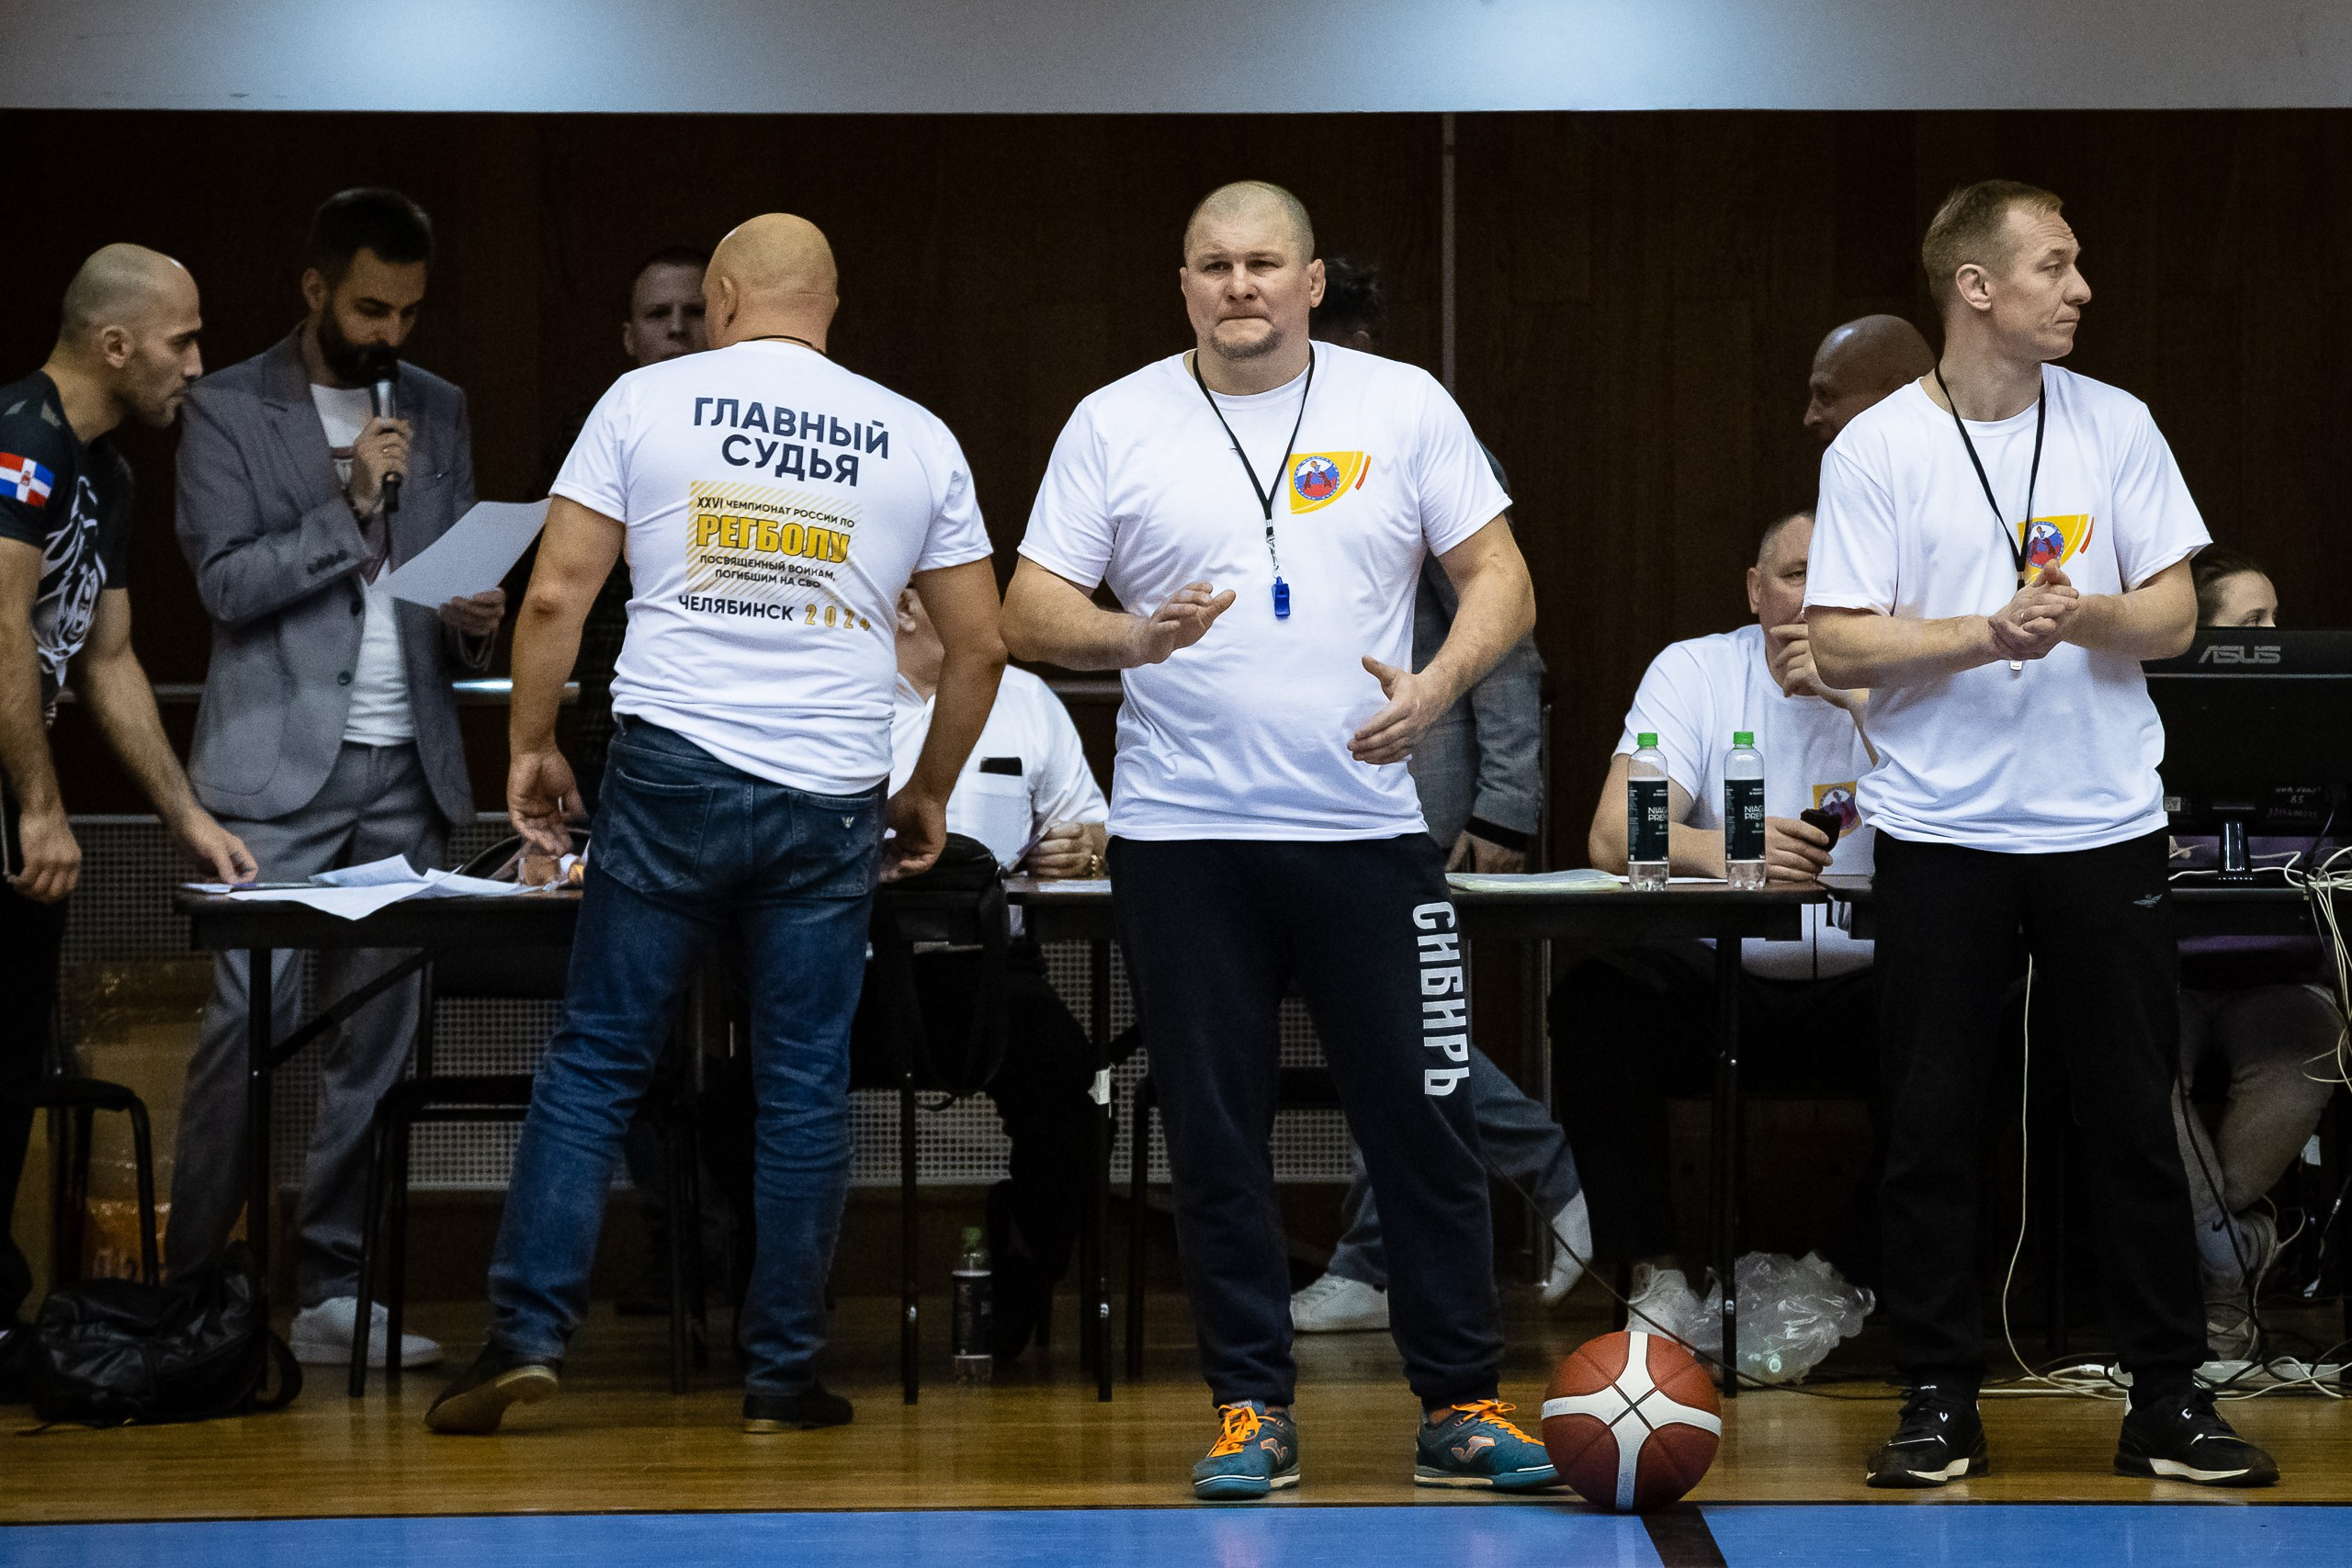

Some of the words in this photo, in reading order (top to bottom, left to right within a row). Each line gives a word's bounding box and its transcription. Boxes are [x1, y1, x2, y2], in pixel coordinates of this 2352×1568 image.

[694, 397, 889, 459] ГЛАВНЫЙ
[721, 434, 859, 487] СУДЬЯ
[696, 497, 723, 509] XXVI
[727, 501, 791, 515] ЧЕМПИОНАТ
[793, 507, 838, 525] РОССИИ
[840, 517, 855, 528] ПО
[696, 513, 851, 564] РЕГБОЛУ
[700, 555, 786, 571] ПОСВЯЩЕННЫЙ
[788, 565, 836, 581] ВОИНАМ,
[715, 569, 777, 583] ПОГИБШИМ
[780, 576, 795, 586] НА
[797, 578, 821, 589] СВО
[678, 595, 795, 621] ЧЕЛЯБИНСК
[2198, 645, 2281, 664] ASUS
[1412, 901, 1470, 1098] СИБИРЬ
